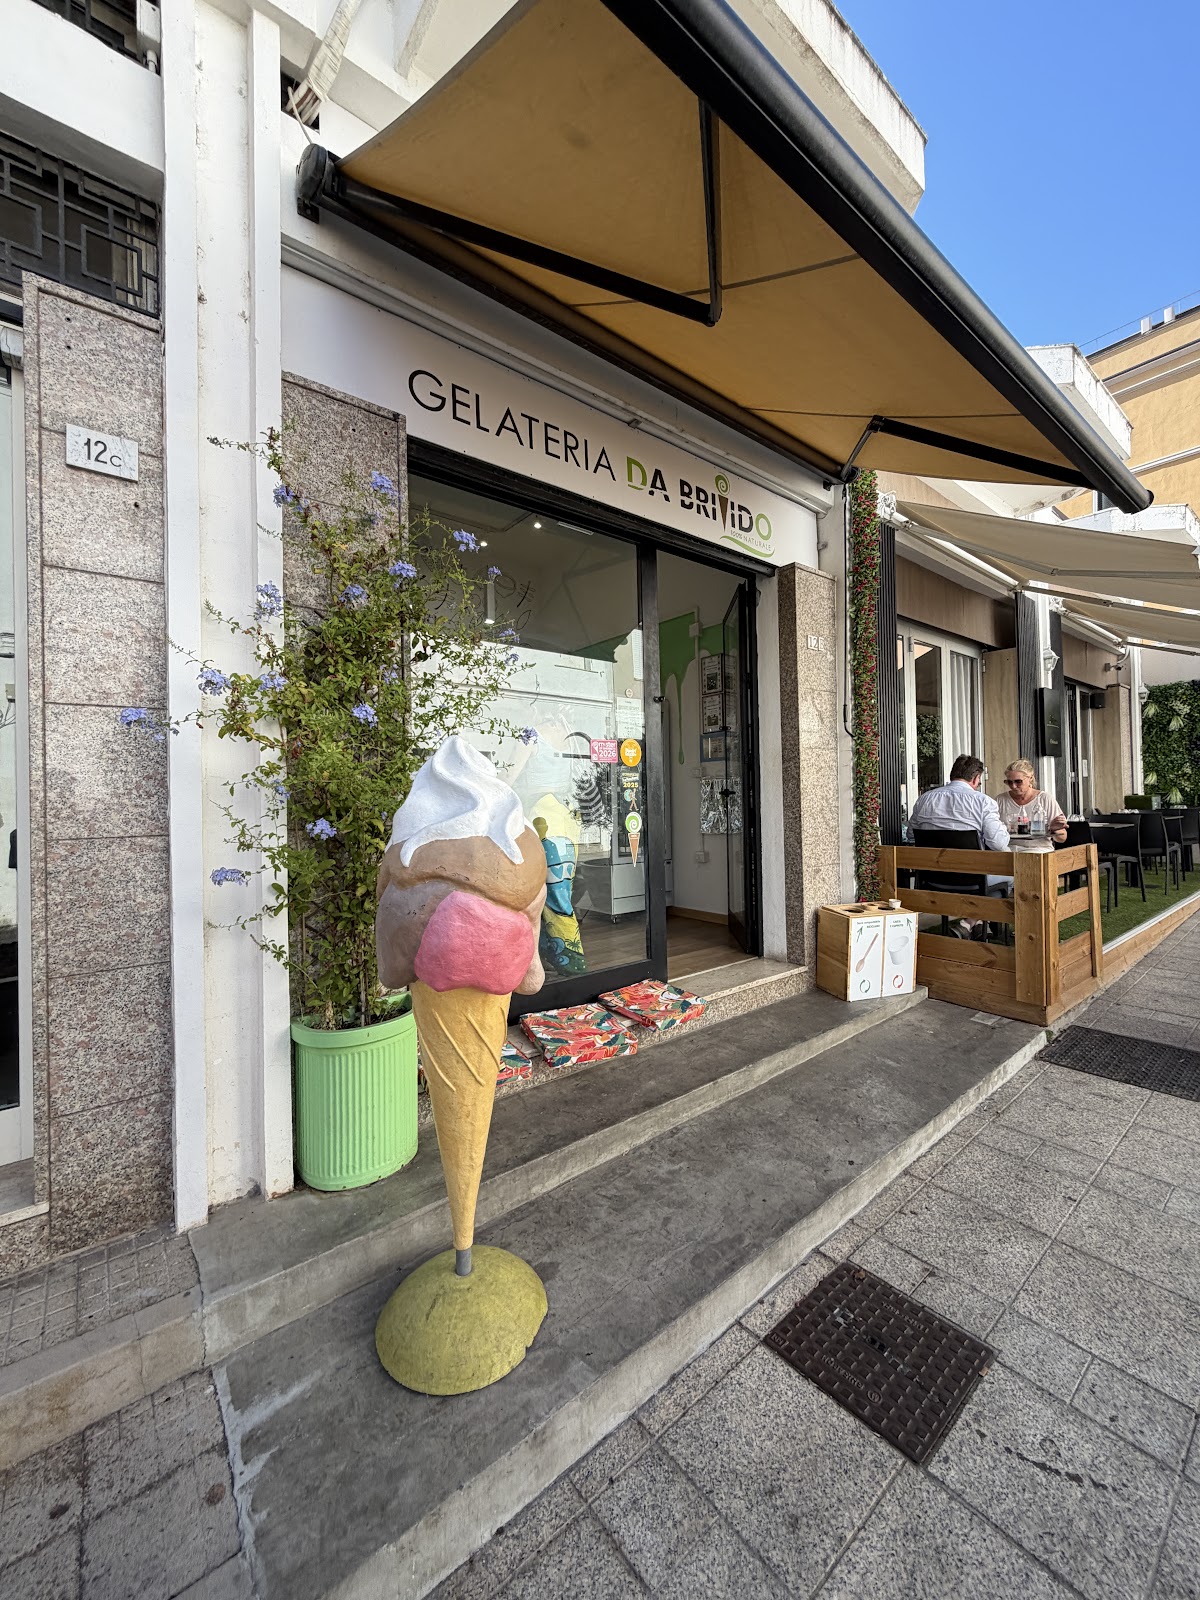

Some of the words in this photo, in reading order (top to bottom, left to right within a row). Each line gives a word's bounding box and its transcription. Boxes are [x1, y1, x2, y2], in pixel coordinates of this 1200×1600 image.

[408, 369, 616, 482] GELATERIA
[626, 456, 671, 503] DA
[743, 536, 772, 551] NATURALE
[599, 750, 616, 758] 2026
